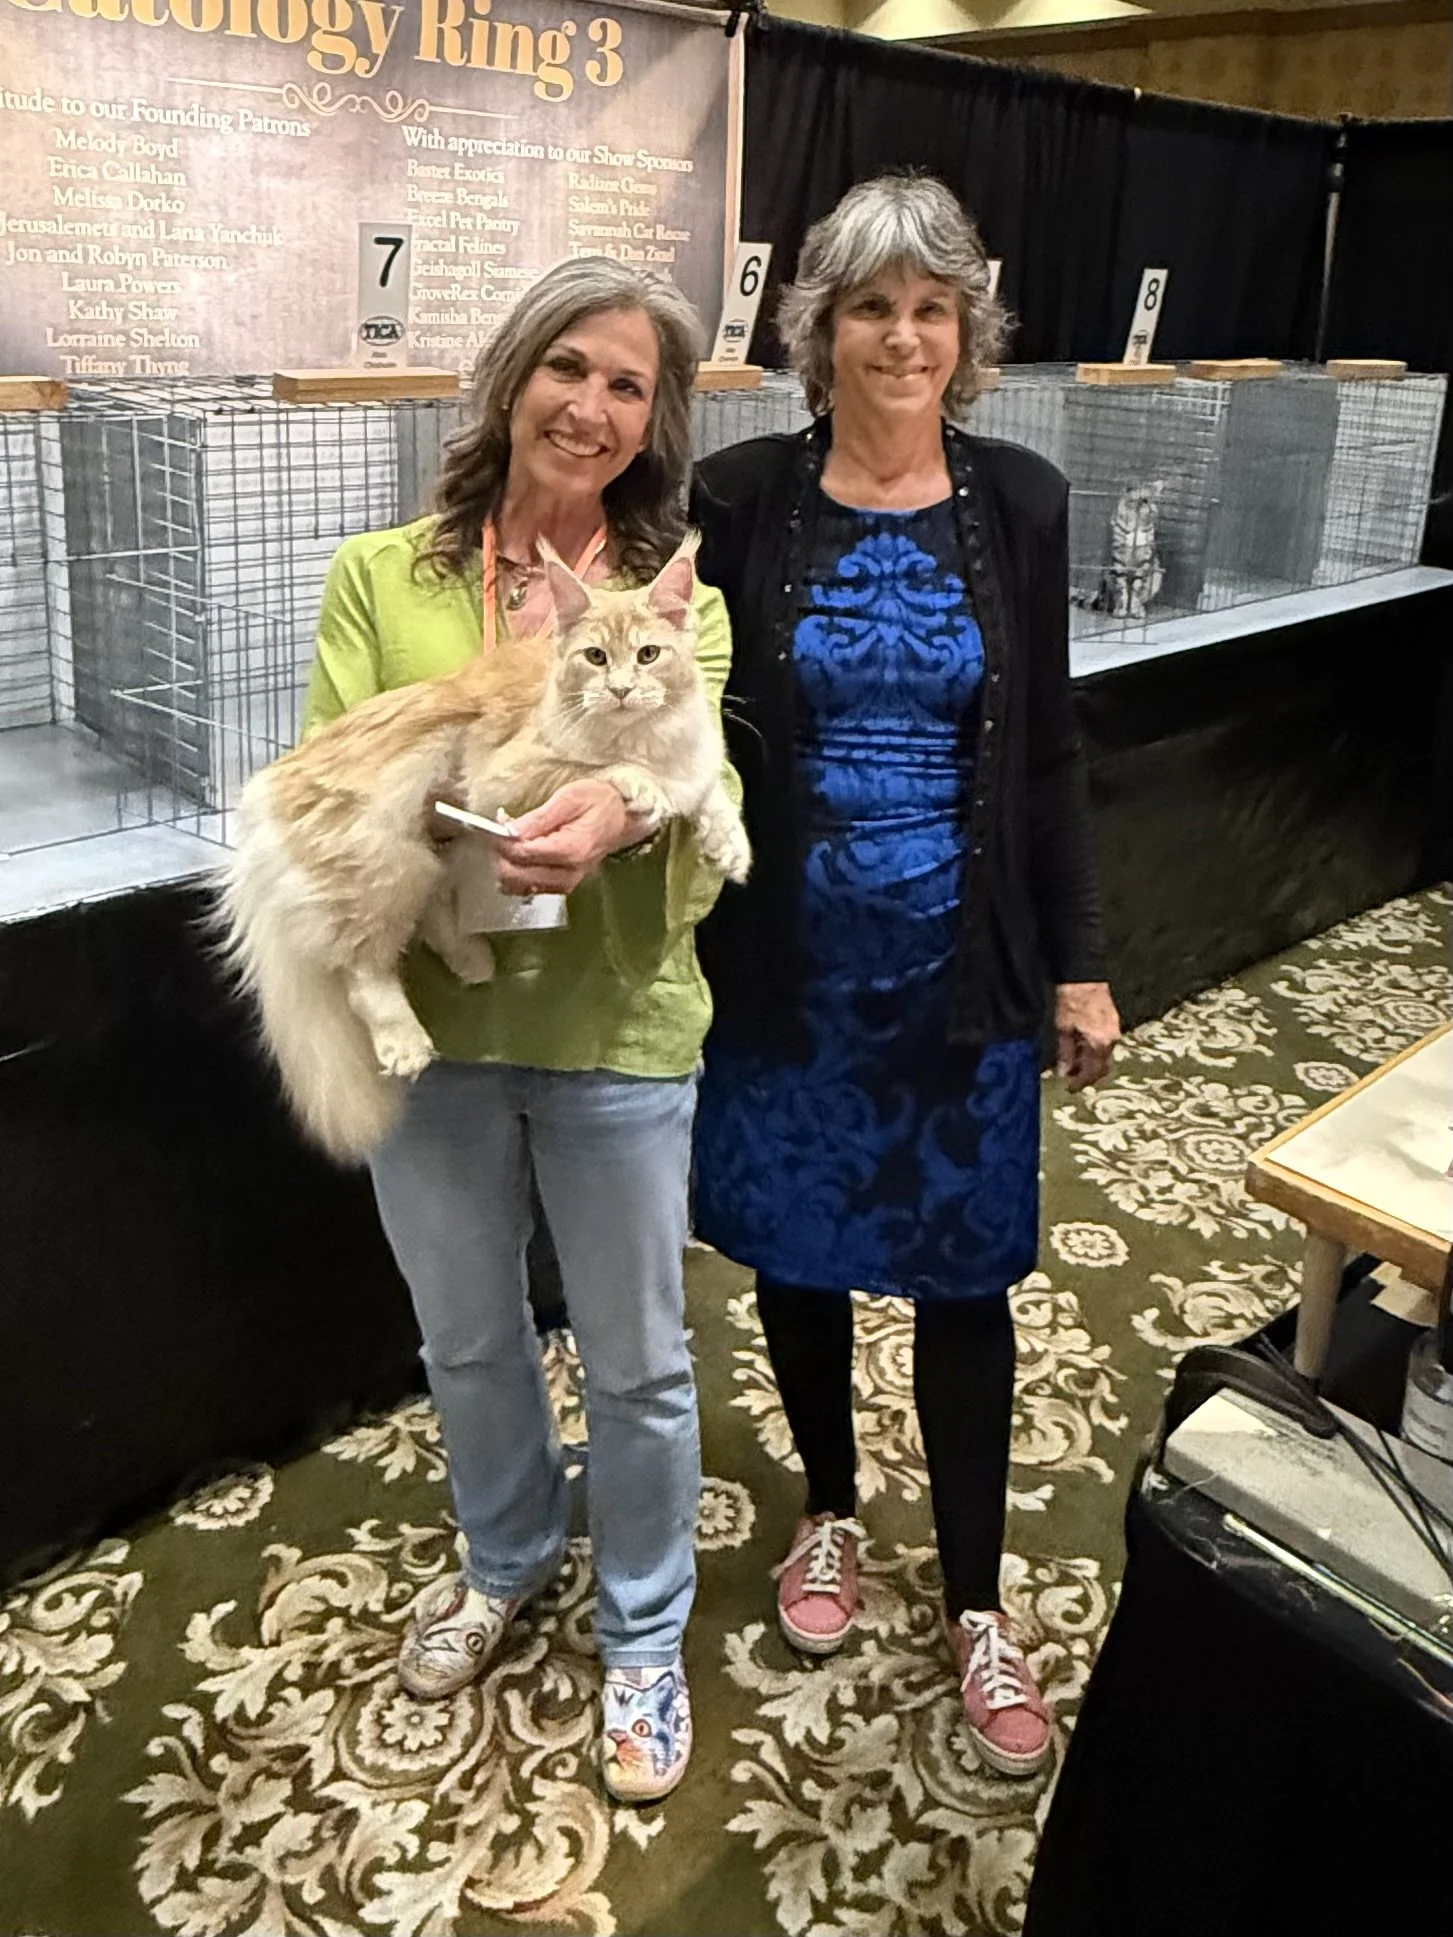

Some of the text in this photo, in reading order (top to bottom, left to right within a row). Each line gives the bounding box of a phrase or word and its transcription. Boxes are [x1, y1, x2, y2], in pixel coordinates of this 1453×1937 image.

[7, 0, 624, 102] ology Ring 3
[61, 96, 85, 116] to
[90, 100, 127, 121] our
[131, 98, 234, 135] Founding
[238, 108, 312, 137] Patrons
[55, 128, 181, 161] Melody Boyd
[401, 124, 446, 150] With
[447, 135, 545, 160] appreciation
[547, 144, 564, 162] to
[565, 149, 591, 164] our
[593, 145, 636, 168] Show
[49, 156, 188, 187] Erica Callahan
[453, 162, 505, 184] Exotics
[52, 185, 186, 214] Melissa Dorko
[455, 187, 510, 211] Bengals
[121, 217, 154, 241] and
[159, 219, 205, 243] Lana
[449, 210, 474, 231] Pet
[475, 212, 521, 237] Pantry
[5, 241, 43, 266] Jon
[46, 245, 84, 265] and
[88, 245, 148, 270] Robyn
[458, 235, 508, 255] Felines
[373, 236, 405, 288] 7
[739, 255, 763, 298] 6
[61, 272, 182, 295] Laura Powers
[1144, 277, 1160, 312] 8
[68, 300, 179, 325] Kathy Shaw
[46, 328, 201, 350] Lorraine Shelton
[59, 355, 191, 377] Tiffany Thyng
